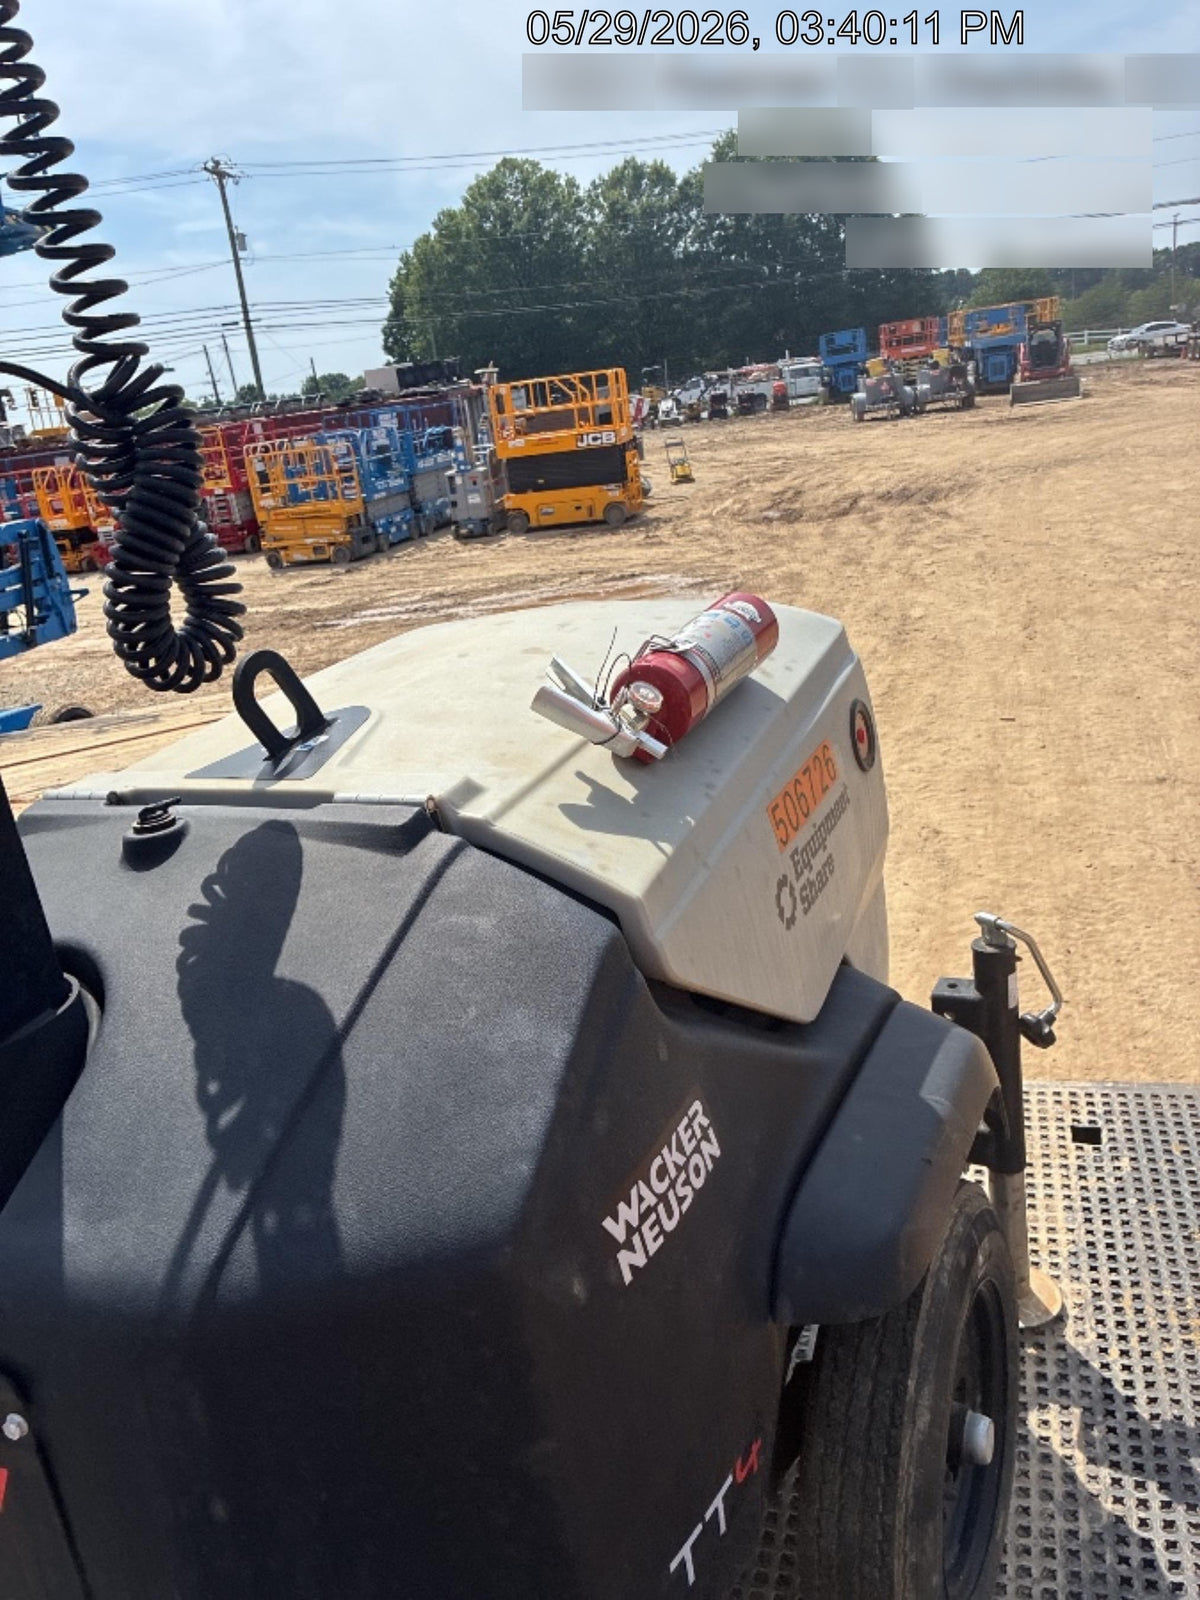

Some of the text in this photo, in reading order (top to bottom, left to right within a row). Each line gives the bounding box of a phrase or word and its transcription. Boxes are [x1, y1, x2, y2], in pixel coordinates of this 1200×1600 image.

[577, 431, 616, 447] JCB
[771, 744, 837, 847] 506726
[790, 782, 850, 882] Equipment
[798, 853, 835, 915] Share
[601, 1100, 710, 1243] WACKER
[616, 1127, 721, 1286] NEUSON
